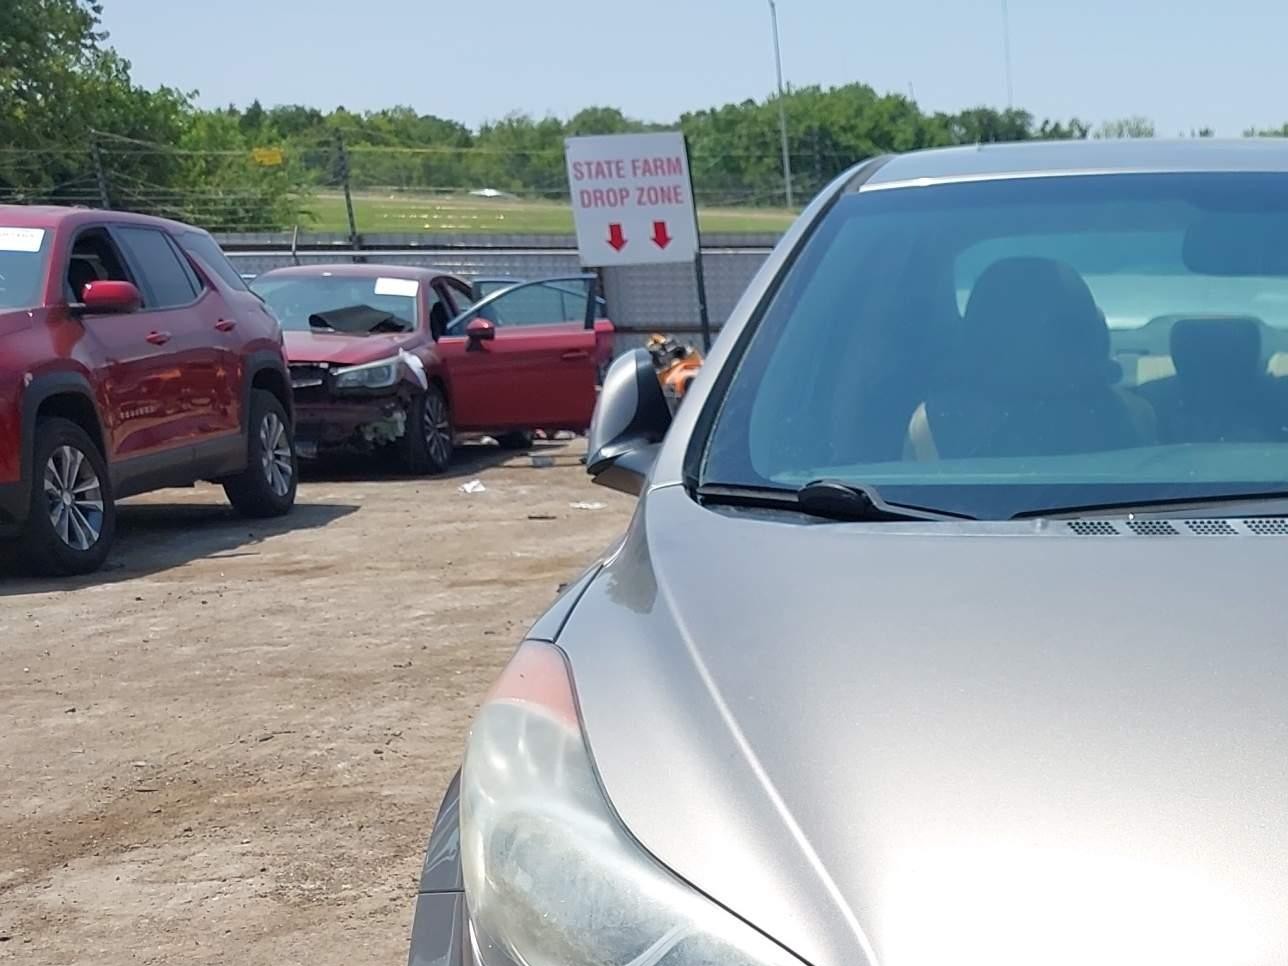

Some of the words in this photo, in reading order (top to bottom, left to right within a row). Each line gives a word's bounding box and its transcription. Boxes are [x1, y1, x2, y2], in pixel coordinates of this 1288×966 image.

[573, 160, 625, 181] STATE
[631, 157, 683, 177] FARM
[580, 188, 630, 208] DROP
[636, 186, 685, 206] ZONE
